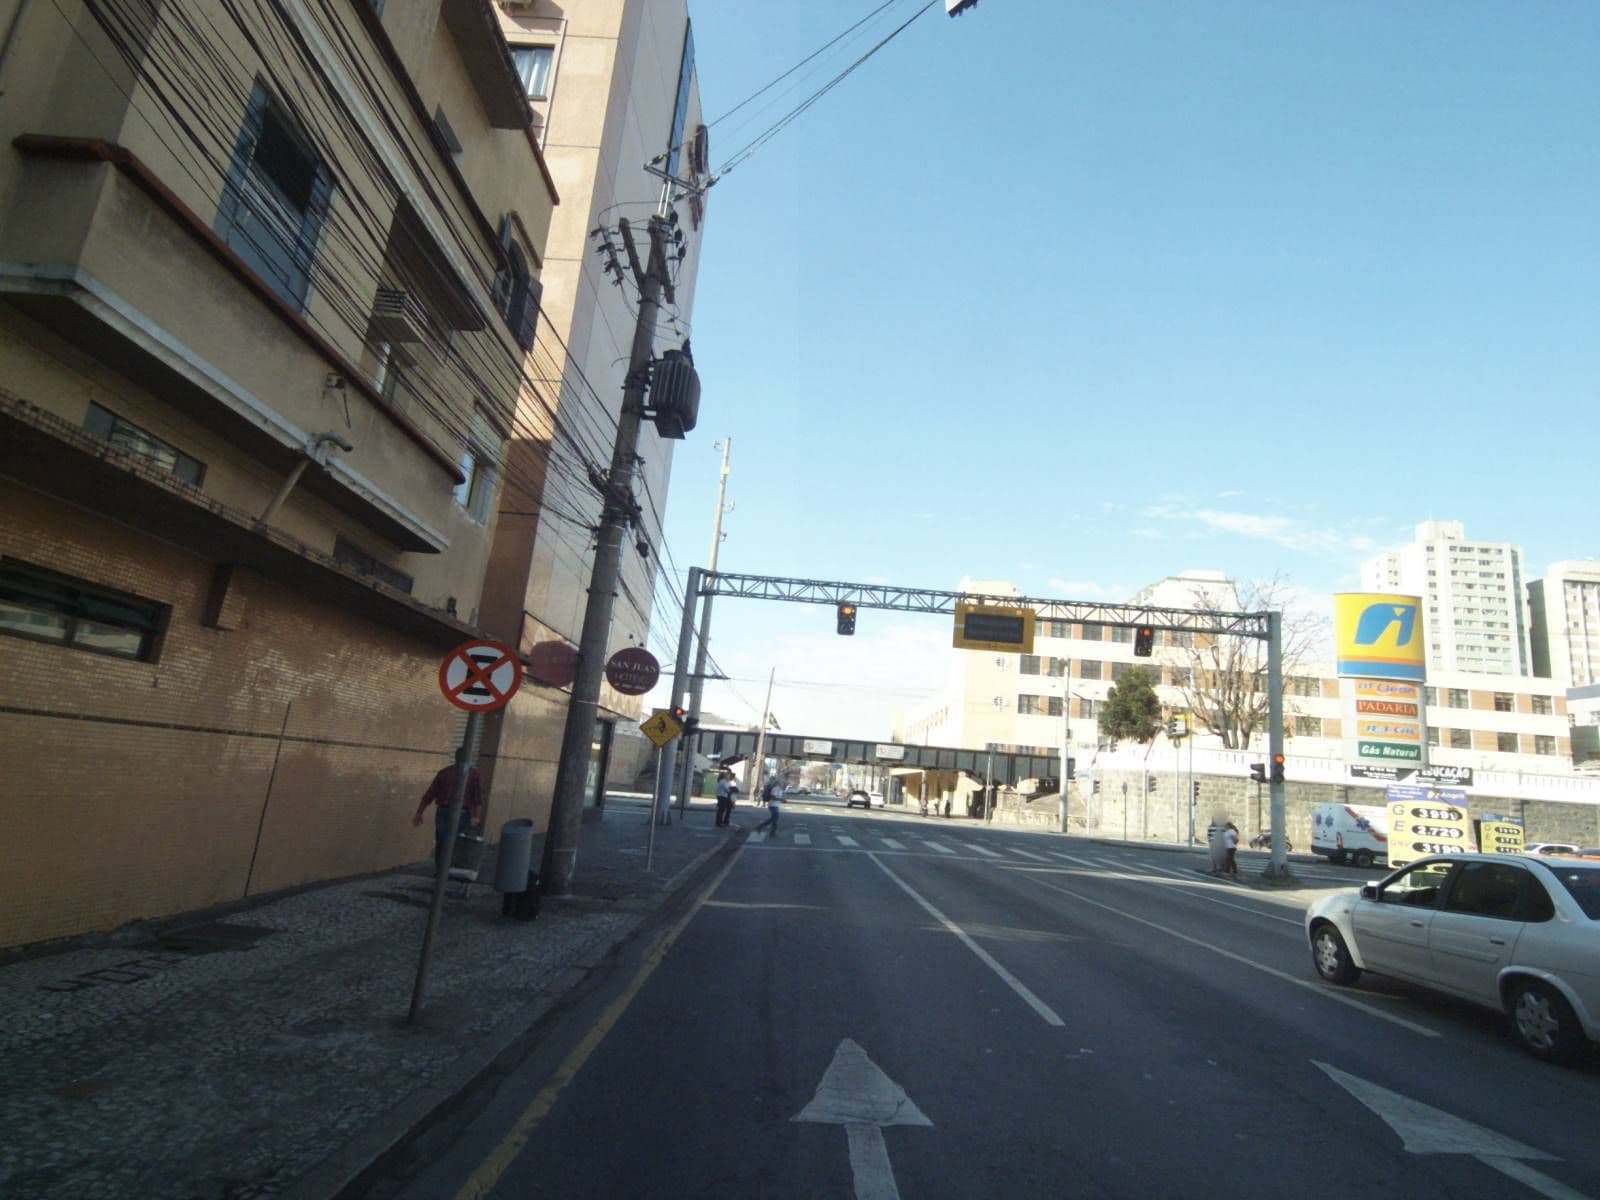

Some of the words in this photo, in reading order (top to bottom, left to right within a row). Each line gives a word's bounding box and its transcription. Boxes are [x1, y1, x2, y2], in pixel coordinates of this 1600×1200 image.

[1359, 701, 1417, 715] PADARIA
[1382, 746, 1418, 758] Natural
[1394, 820, 1406, 832] E
